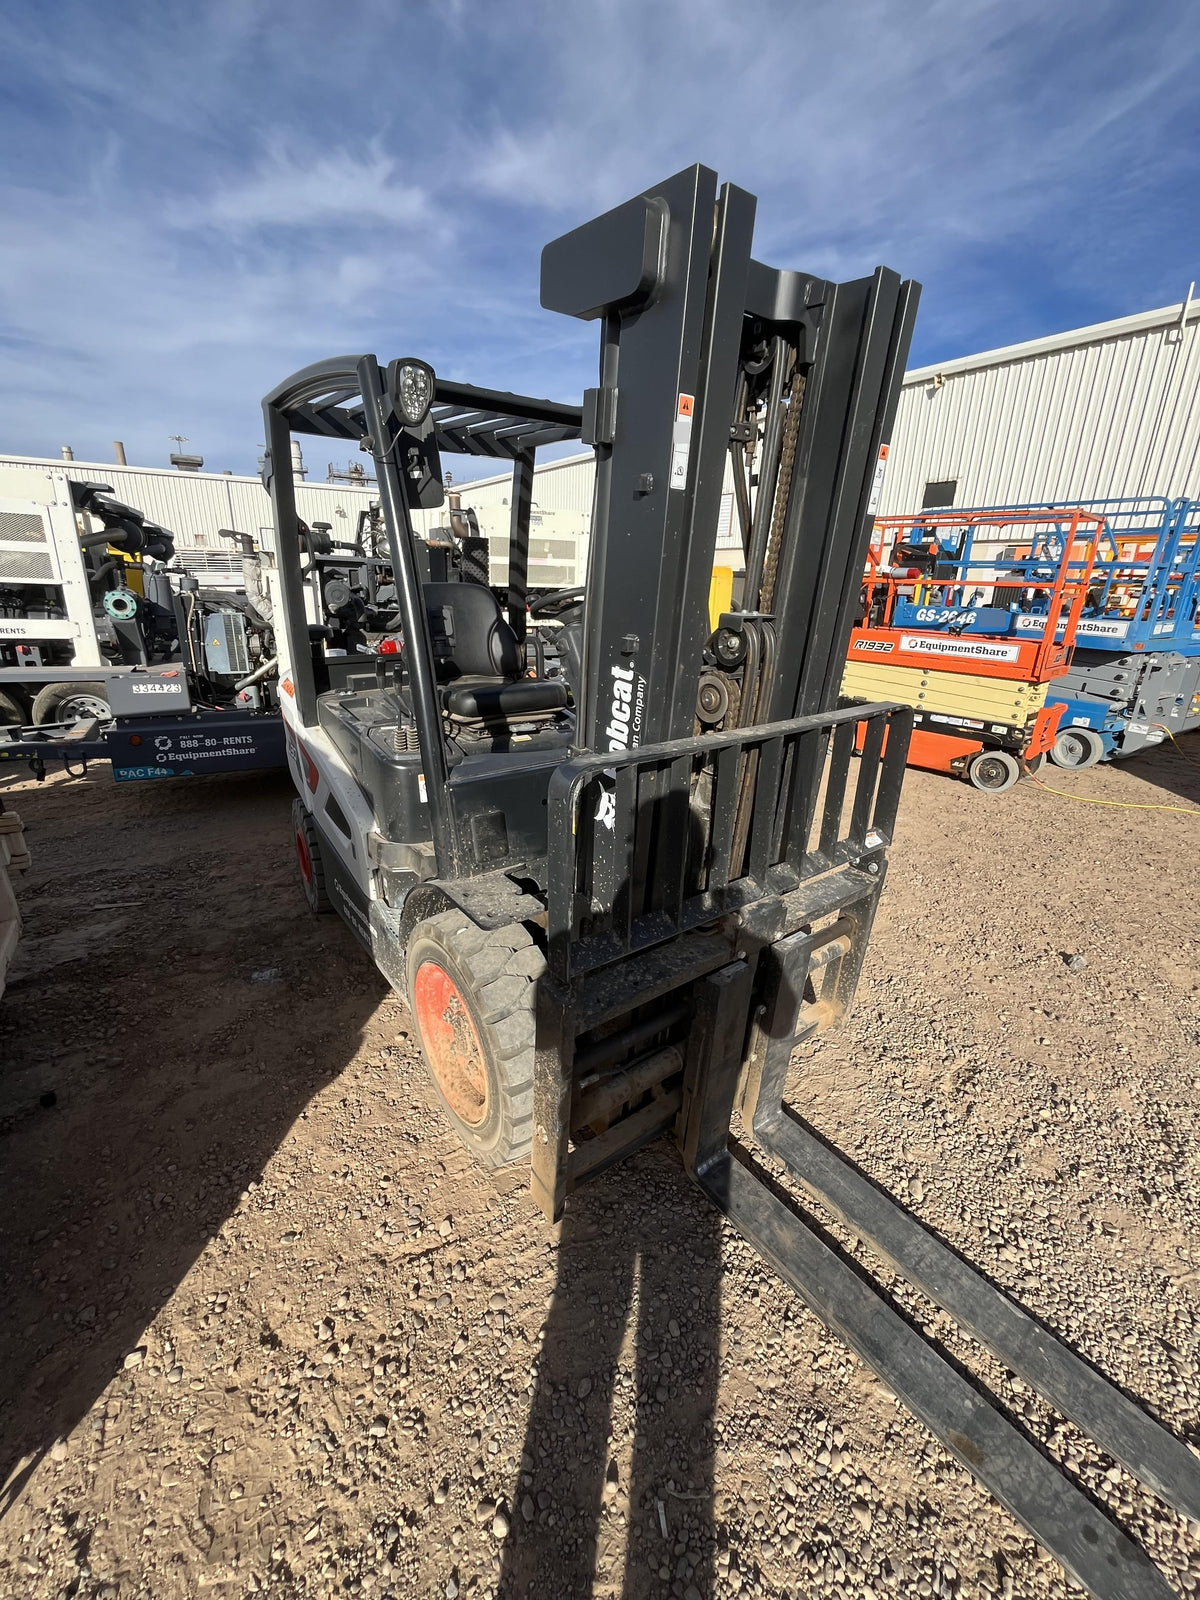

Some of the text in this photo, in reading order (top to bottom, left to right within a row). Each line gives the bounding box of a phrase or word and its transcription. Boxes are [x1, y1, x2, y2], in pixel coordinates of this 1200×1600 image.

[1032, 619, 1118, 634] EqmntShare
[853, 640, 895, 652] R1932
[919, 640, 1008, 657] EquipmentShare
[632, 676, 647, 731] Company
[180, 735, 253, 749] 888-80-RENTS
[168, 747, 257, 762] EquipmentShare
